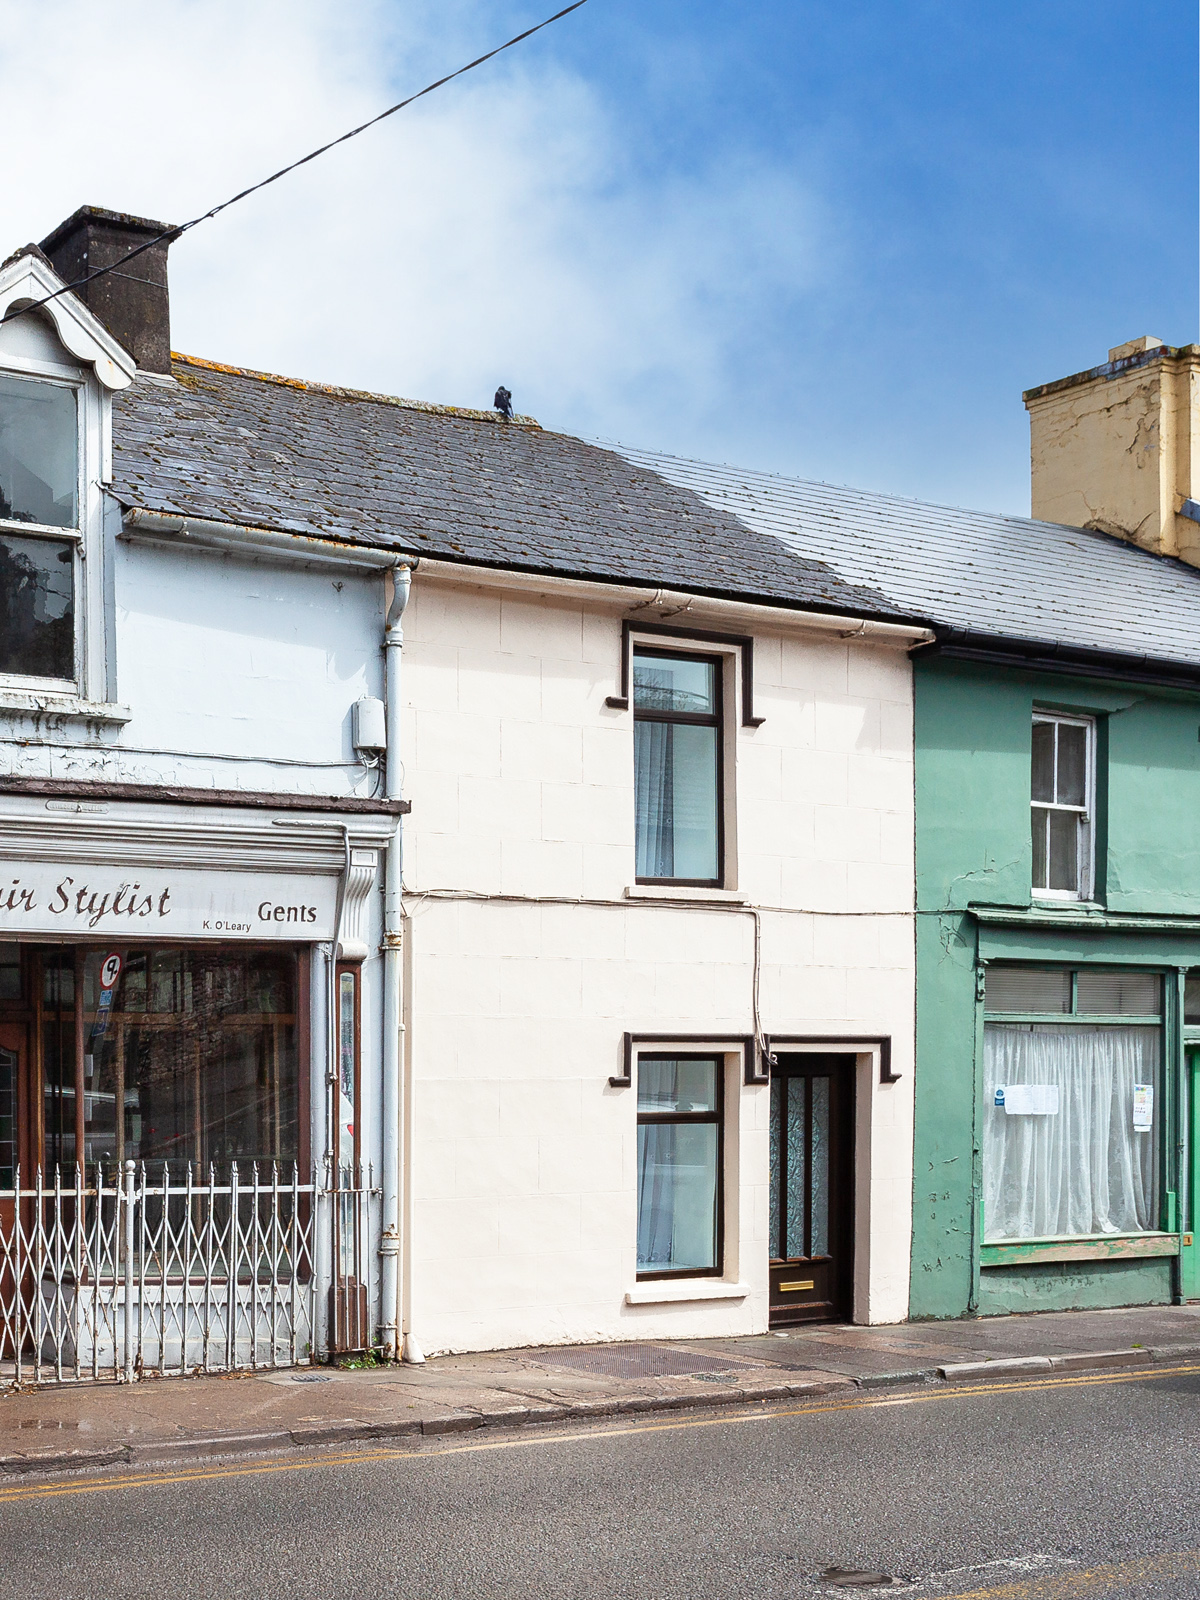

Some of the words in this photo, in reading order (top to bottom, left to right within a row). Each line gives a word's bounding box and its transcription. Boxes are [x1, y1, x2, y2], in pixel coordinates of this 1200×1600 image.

[48, 876, 171, 928] Stylist
[257, 901, 317, 923] Gents
[202, 920, 212, 930] K.
[215, 920, 252, 933] O'Leary
